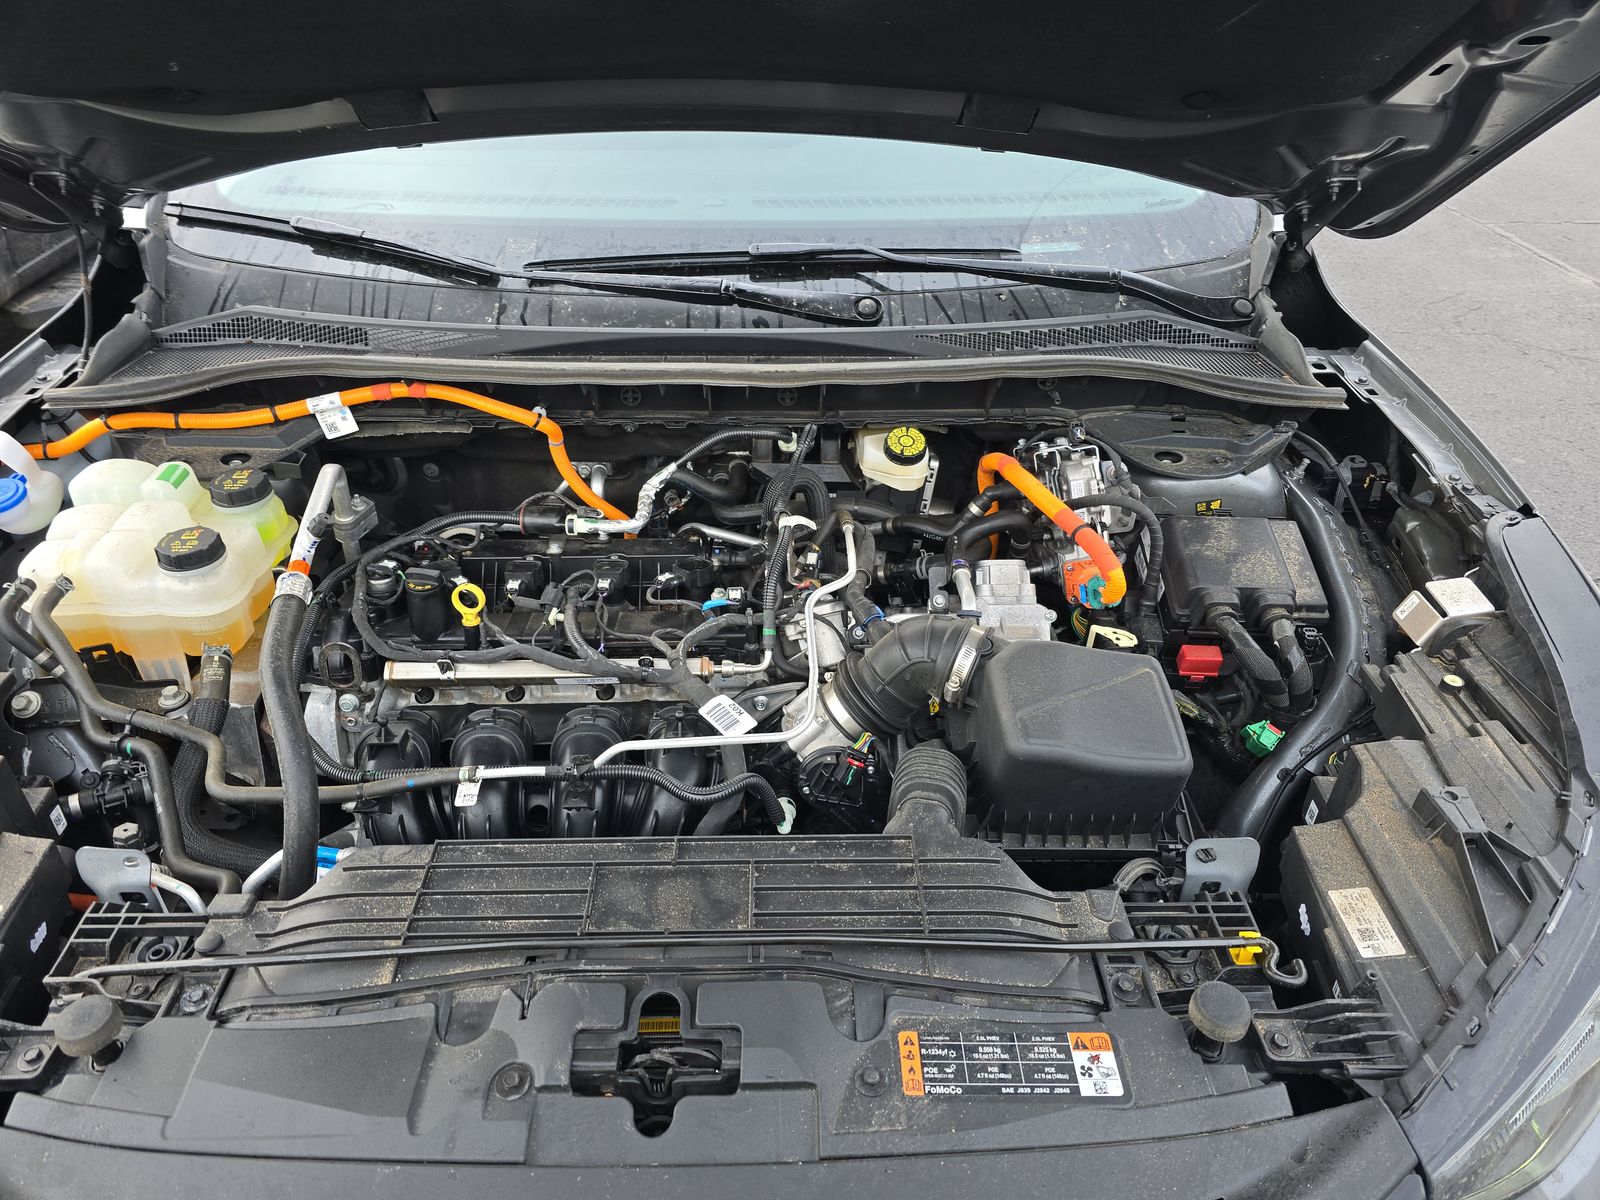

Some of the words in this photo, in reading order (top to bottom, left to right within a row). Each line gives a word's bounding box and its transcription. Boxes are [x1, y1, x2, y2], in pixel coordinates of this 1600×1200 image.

[921, 1048, 948, 1056] R-1234yf
[923, 1066, 939, 1074] POE
[925, 1085, 962, 1094] FoMoCo
